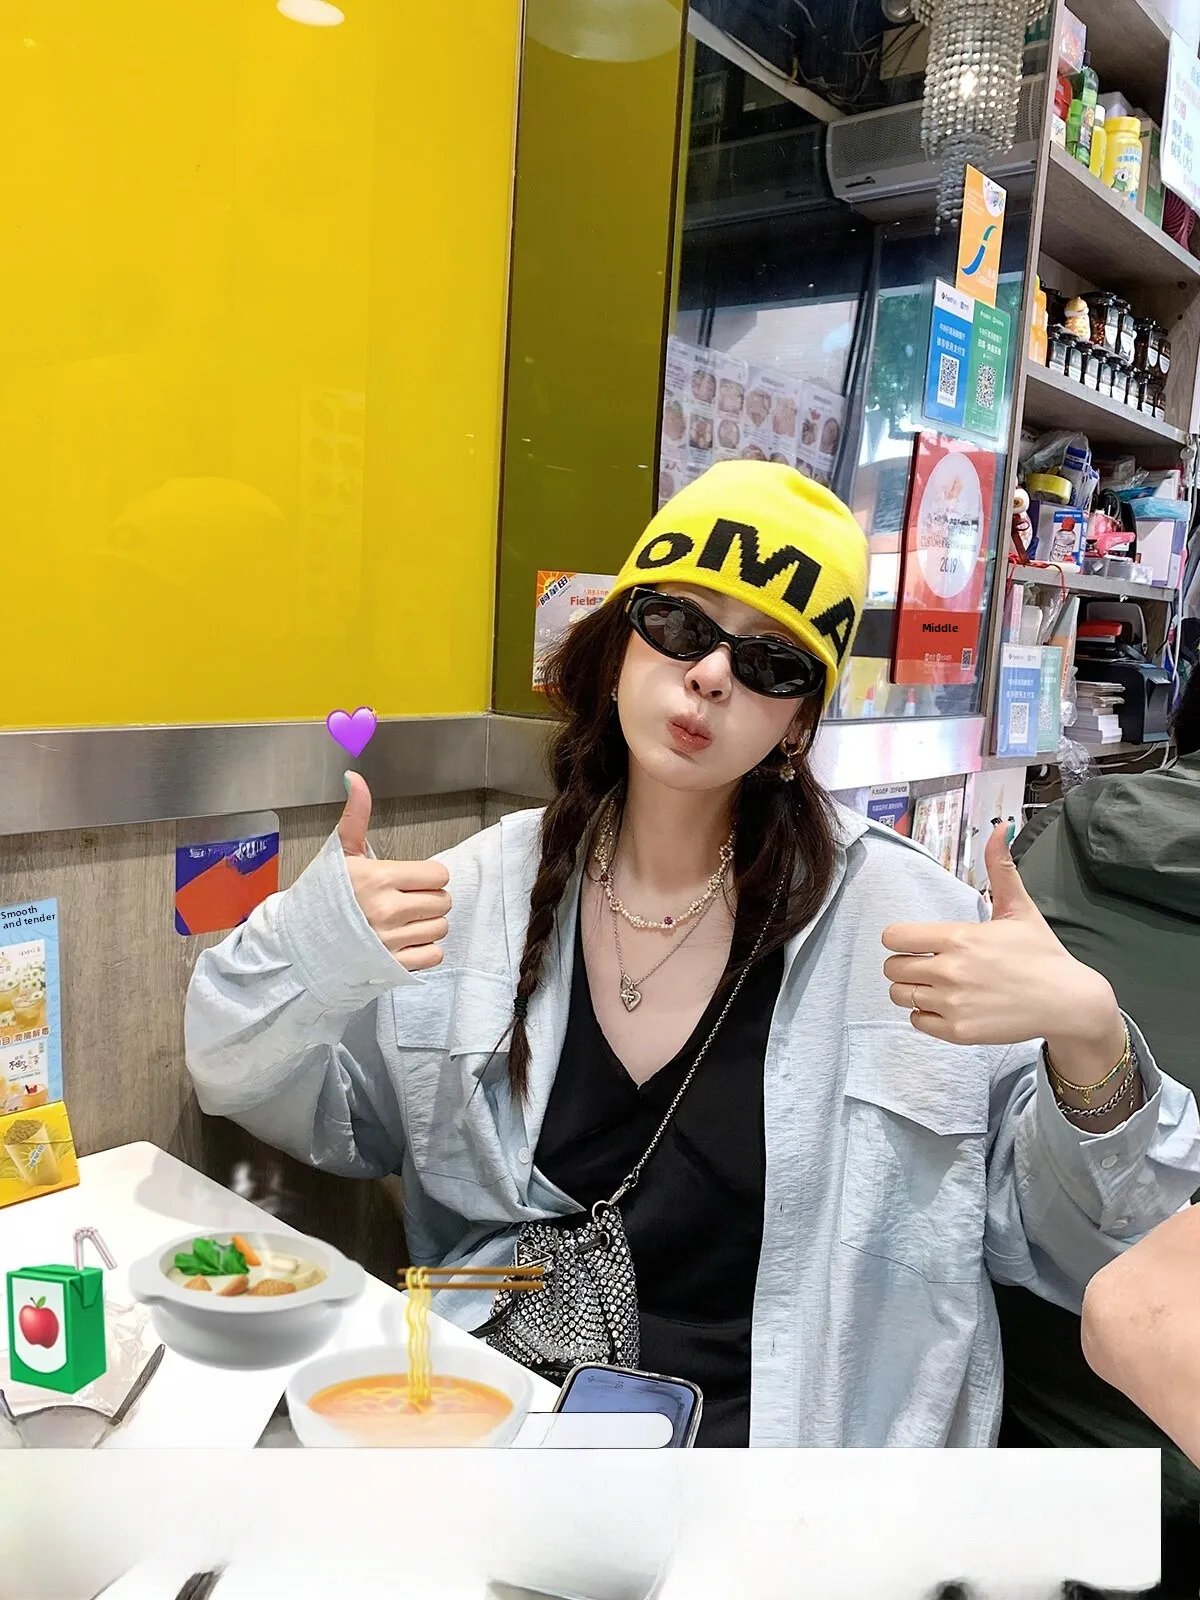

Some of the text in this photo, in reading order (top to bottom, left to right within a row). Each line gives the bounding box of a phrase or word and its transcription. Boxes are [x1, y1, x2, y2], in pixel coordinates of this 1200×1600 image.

[939, 556, 958, 573] 2019
[570, 596, 596, 606] Field
[922, 622, 959, 633] Middle
[0, 905, 38, 920] Smooth
[3, 913, 56, 930] and tender
[519, 1244, 542, 1259] PRADA
